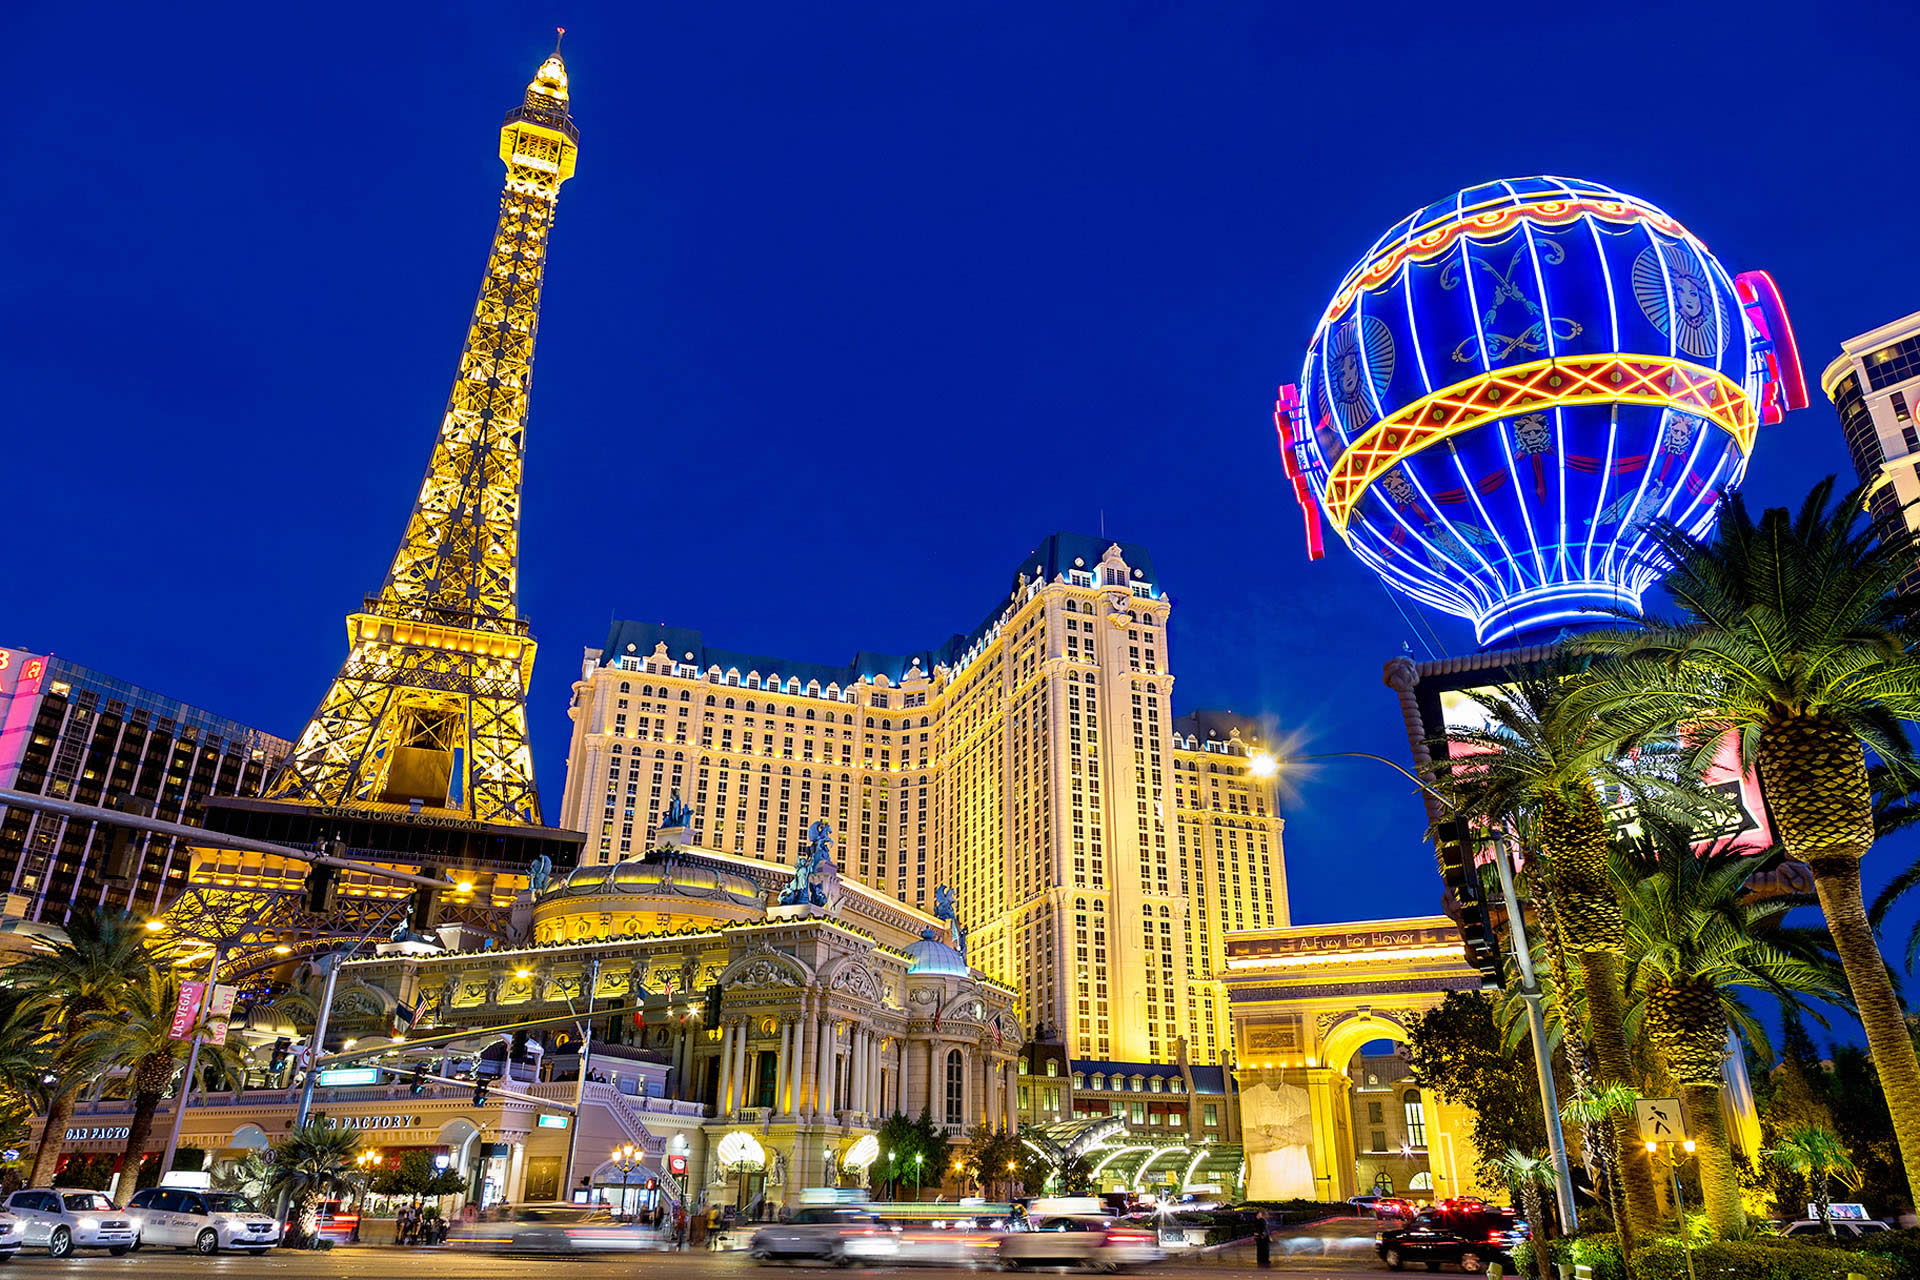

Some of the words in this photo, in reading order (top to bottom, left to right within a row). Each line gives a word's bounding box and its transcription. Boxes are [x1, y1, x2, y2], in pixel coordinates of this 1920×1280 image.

[321, 807, 362, 818] EIFFEL
[367, 810, 408, 823] TOWER
[413, 815, 483, 830] RESTAURANT
[1299, 938, 1308, 950] A
[1313, 936, 1340, 952] Fury
[1345, 934, 1367, 947] For
[222, 993, 234, 1010] LAS
[170, 1019, 184, 1037] LAS
[177, 987, 192, 1017] VEGAS
[342, 1115, 413, 1130] FACTORY
[65, 1128, 88, 1139] GAR
[90, 1127, 130, 1139] FACTO
